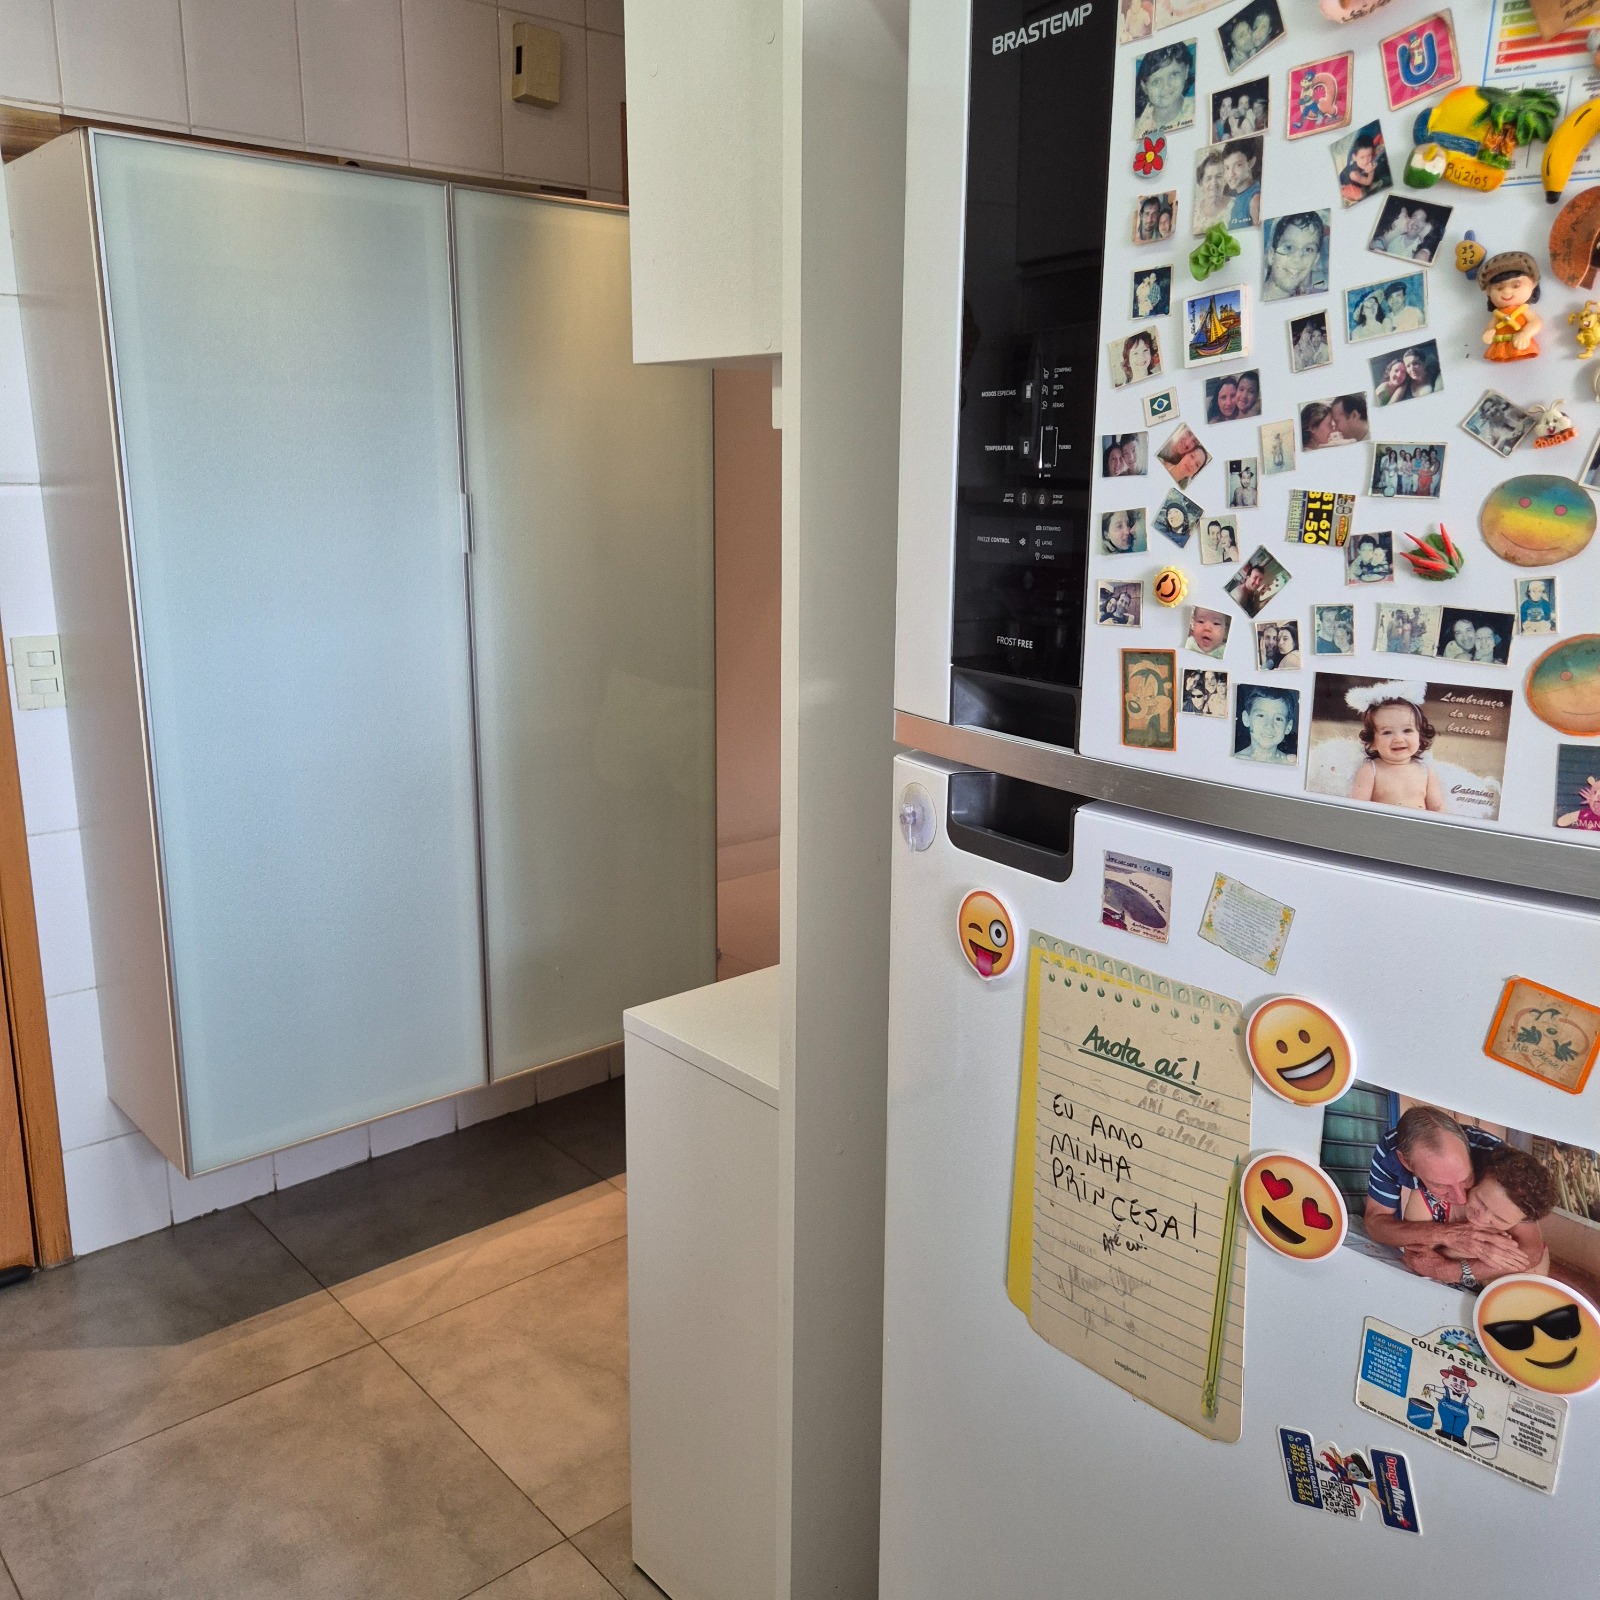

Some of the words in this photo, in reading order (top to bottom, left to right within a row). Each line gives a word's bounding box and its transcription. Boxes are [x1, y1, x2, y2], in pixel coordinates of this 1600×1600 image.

[992, 3, 1092, 55] BRASTEMP
[1397, 31, 1438, 86] U
[1446, 162, 1488, 188] Búzios
[996, 635, 1017, 646] FROST
[1017, 638, 1034, 649] FREE
[1440, 692, 1504, 708] Lembrança
[1449, 709, 1463, 718] do
[1468, 713, 1492, 722] meu
[1451, 784, 1494, 799] Catarina
[1082, 1024, 1146, 1067] Anota
[1091, 1114, 1144, 1150] AMO
[1371, 1335, 1386, 1344] LIXO
[1114, 1358, 1147, 1381] imaginarium
[1411, 1337, 1456, 1362] COLETA
[1458, 1358, 1518, 1388] SELETIVA
[1511, 1407, 1556, 1429] EMBALAGENS
[1289, 1443, 1307, 1501] 99631-2669
[1304, 1444, 1315, 1474] ENTREGA
[1297, 1444, 1315, 1504] 3945-3737
